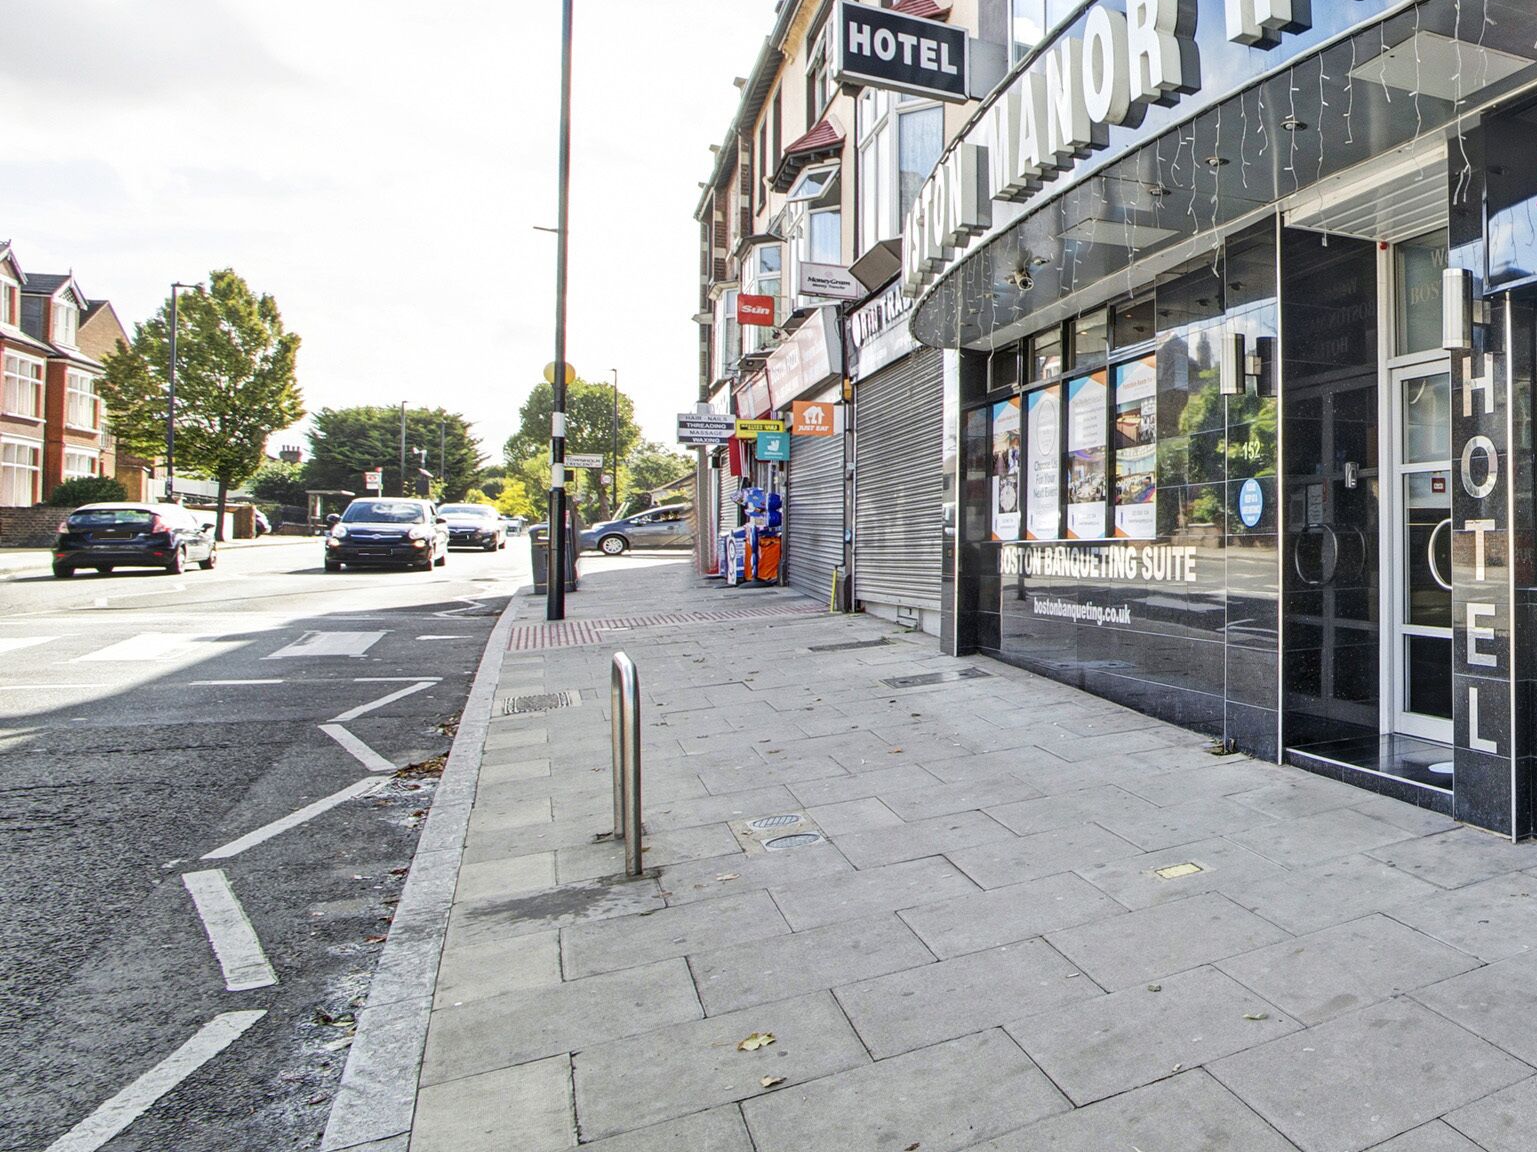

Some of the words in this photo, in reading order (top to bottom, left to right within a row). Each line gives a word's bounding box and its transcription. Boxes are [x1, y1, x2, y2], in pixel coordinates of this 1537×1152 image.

[848, 20, 958, 75] HOTEL
[807, 275, 851, 286] MoneyGram
[1242, 440, 1261, 460] 152
[997, 546, 1041, 576] BOSTON
[1044, 545, 1137, 580] BANQUETING
[1141, 546, 1197, 582] SUITE
[1461, 351, 1500, 754] HOTEL
[1033, 597, 1131, 626] bostonbanqueting.co.uk
